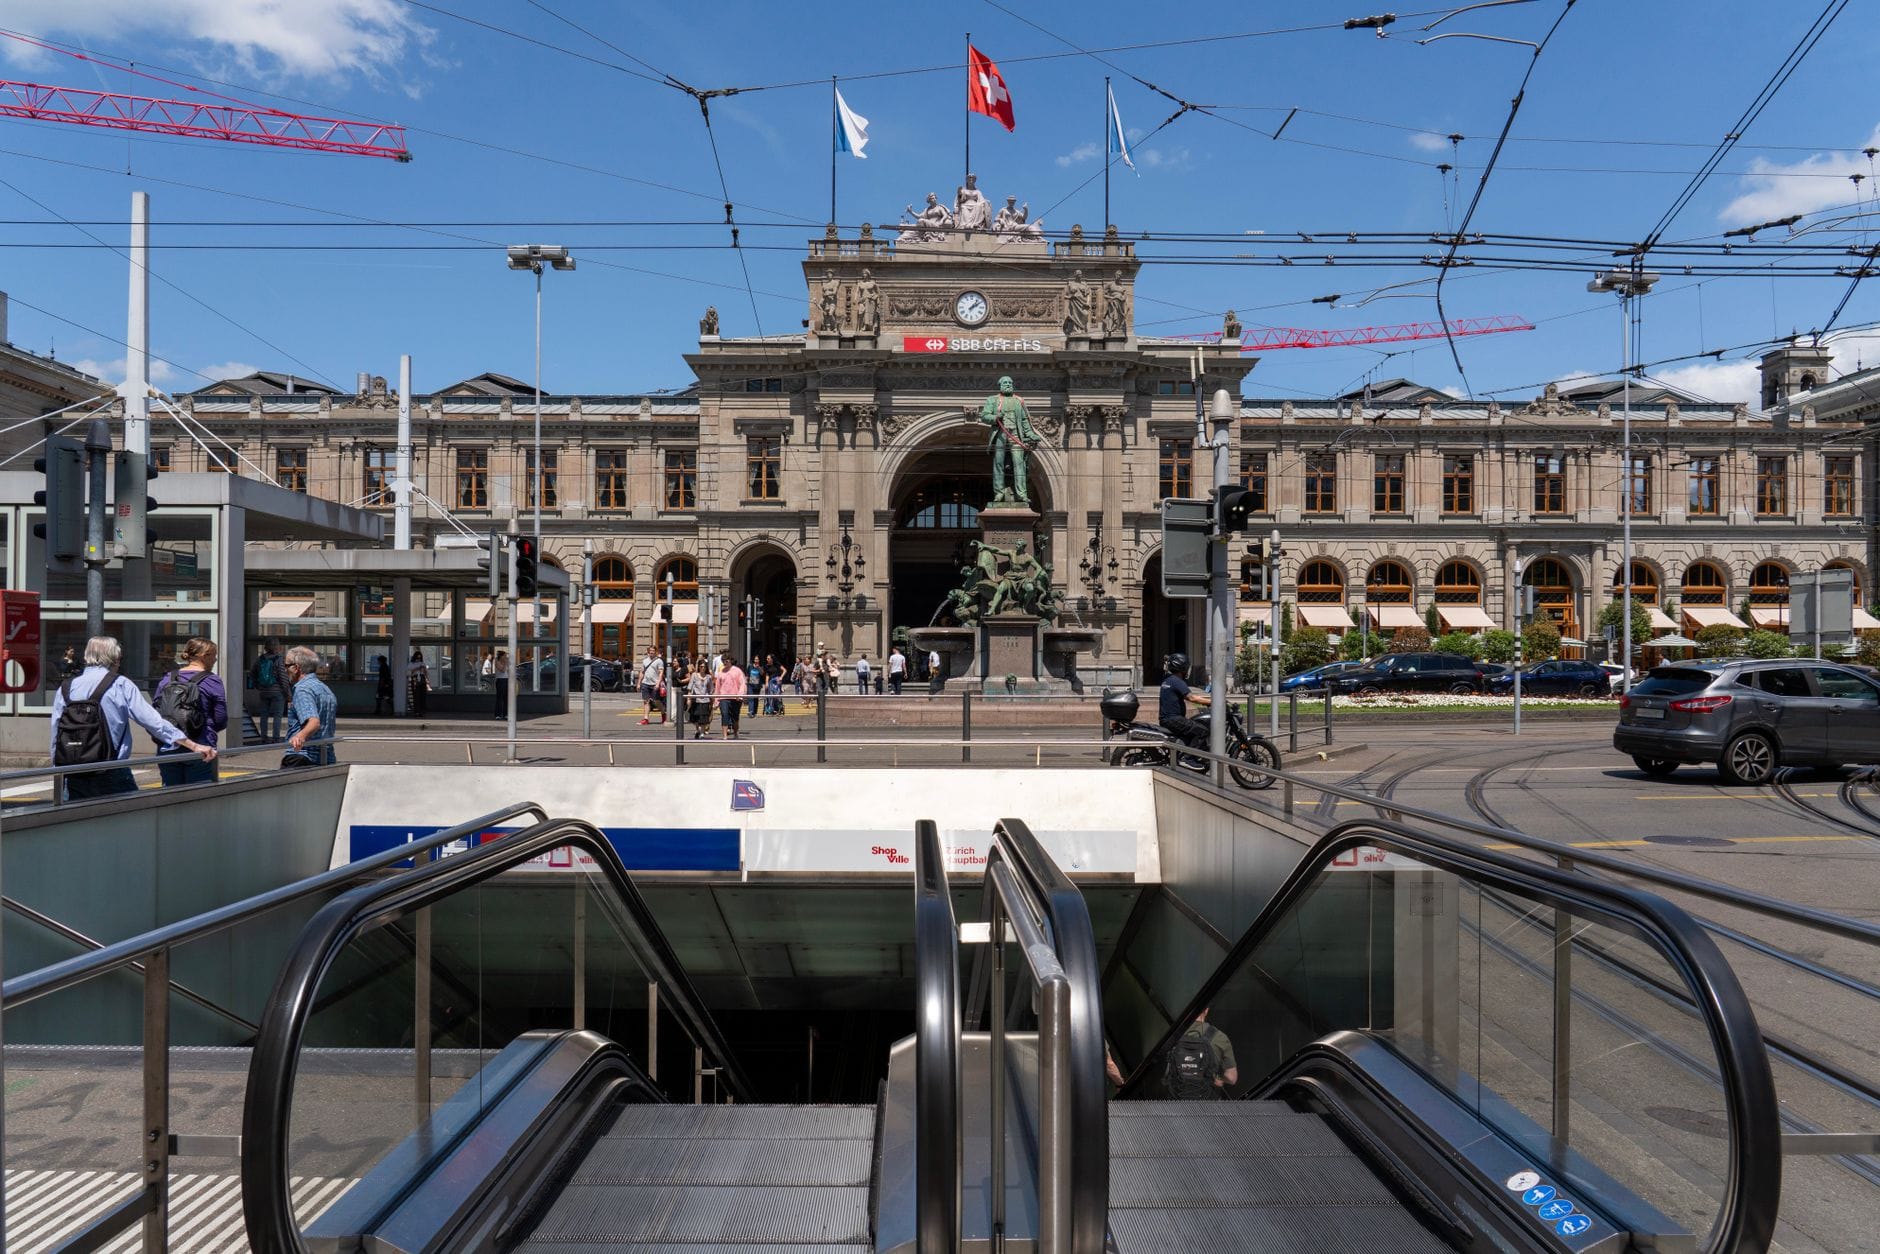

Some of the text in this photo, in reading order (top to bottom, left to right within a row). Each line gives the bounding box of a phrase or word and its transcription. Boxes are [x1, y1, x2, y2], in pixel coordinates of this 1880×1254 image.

[951, 339, 1041, 351] SBB CFF FFS
[871, 846, 897, 857] Shop
[887, 855, 909, 863] Ville
